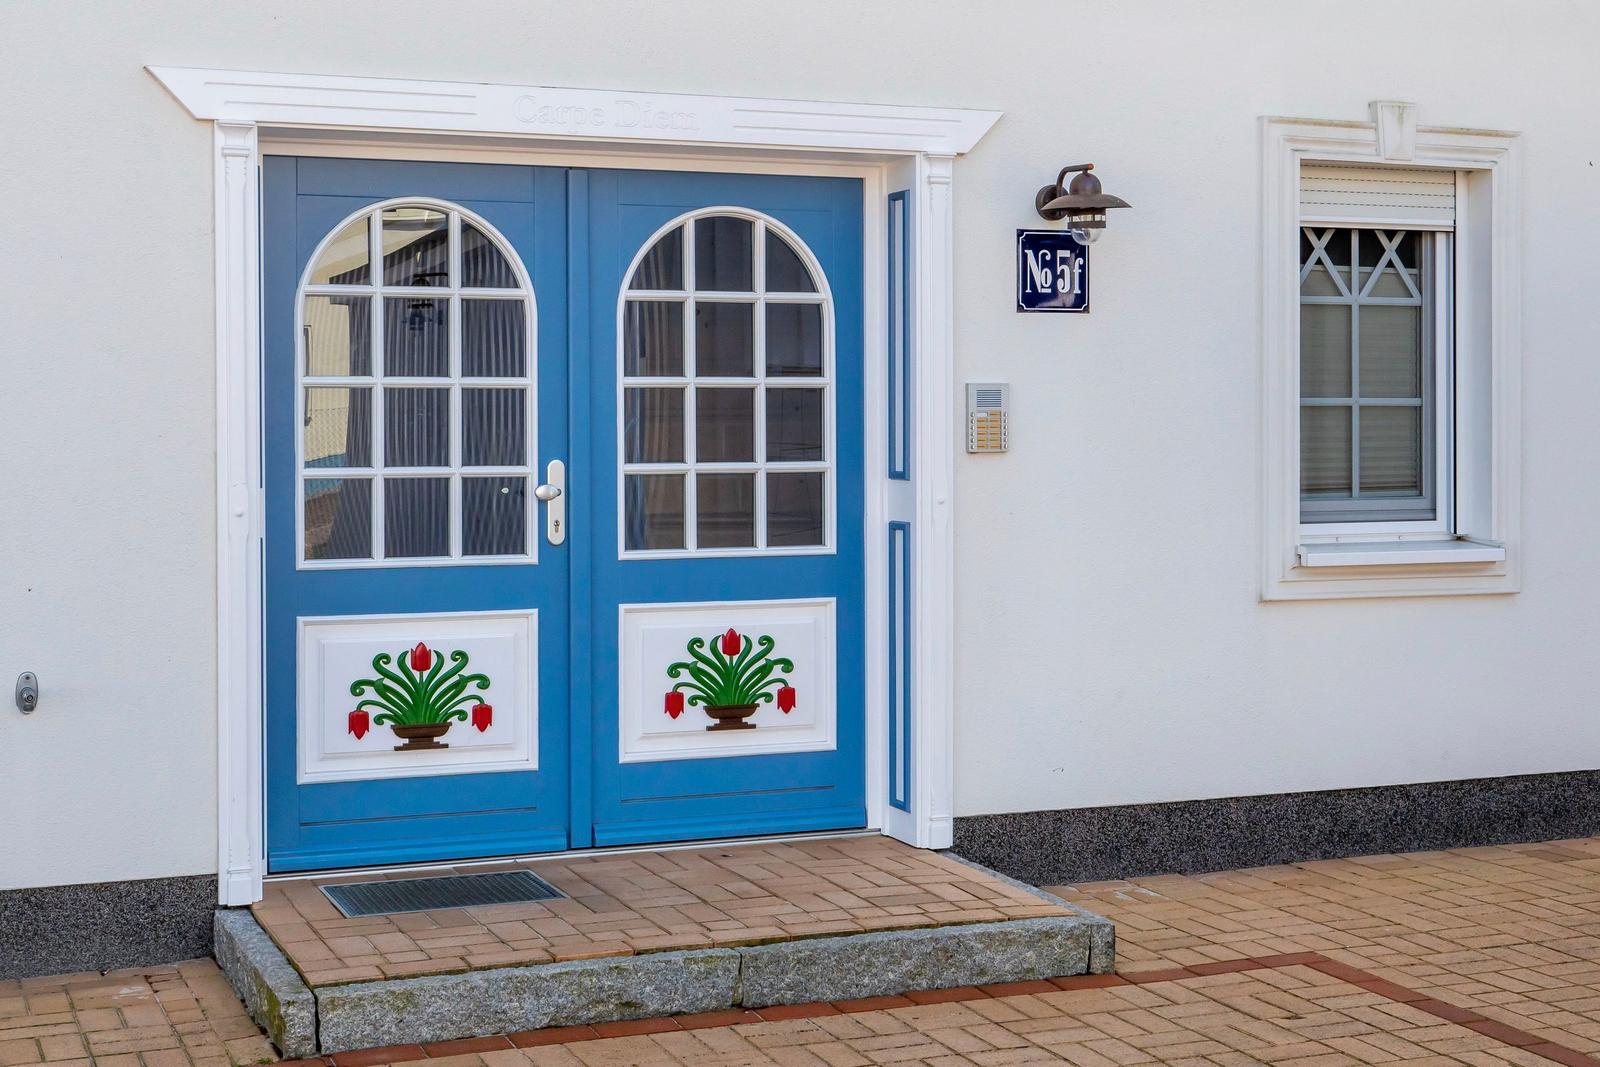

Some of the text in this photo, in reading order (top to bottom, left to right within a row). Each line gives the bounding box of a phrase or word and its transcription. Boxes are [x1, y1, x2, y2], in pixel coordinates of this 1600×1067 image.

[513, 94, 698, 133] Carpe Diem
[1056, 249, 1084, 294] 5f
